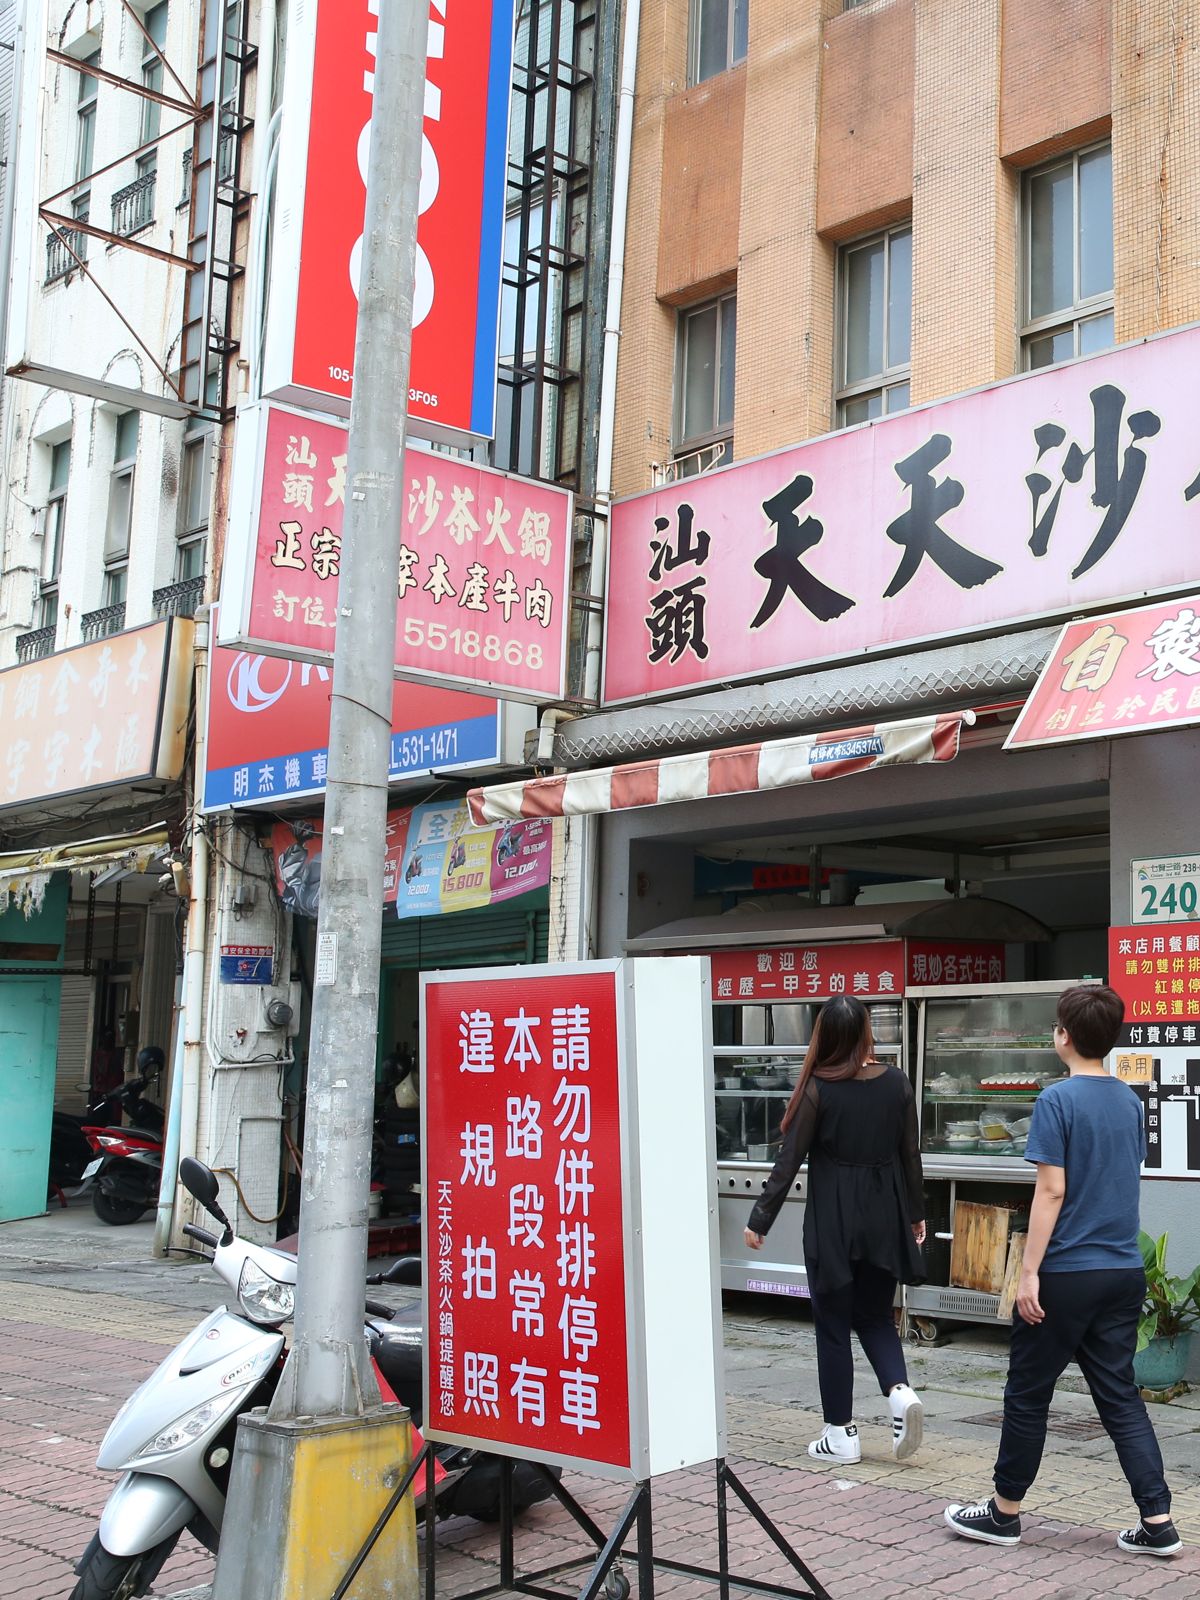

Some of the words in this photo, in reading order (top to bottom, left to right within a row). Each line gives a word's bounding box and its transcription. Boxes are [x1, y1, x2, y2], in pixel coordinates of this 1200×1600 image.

[403, 617, 545, 671] 5518868
[646, 503, 711, 664] 汕頭
[757, 951, 818, 972] 歡迎您
[912, 954, 1000, 983] 現炒各式牛肉
[1141, 882, 1197, 916] 240
[458, 1008, 500, 1420] 違規拍照
[503, 1006, 548, 1428] 本路段常有
[551, 1004, 601, 1436] 請勿併排停車
[438, 1180, 455, 1417] 天天沙茶火鍋提醒您
